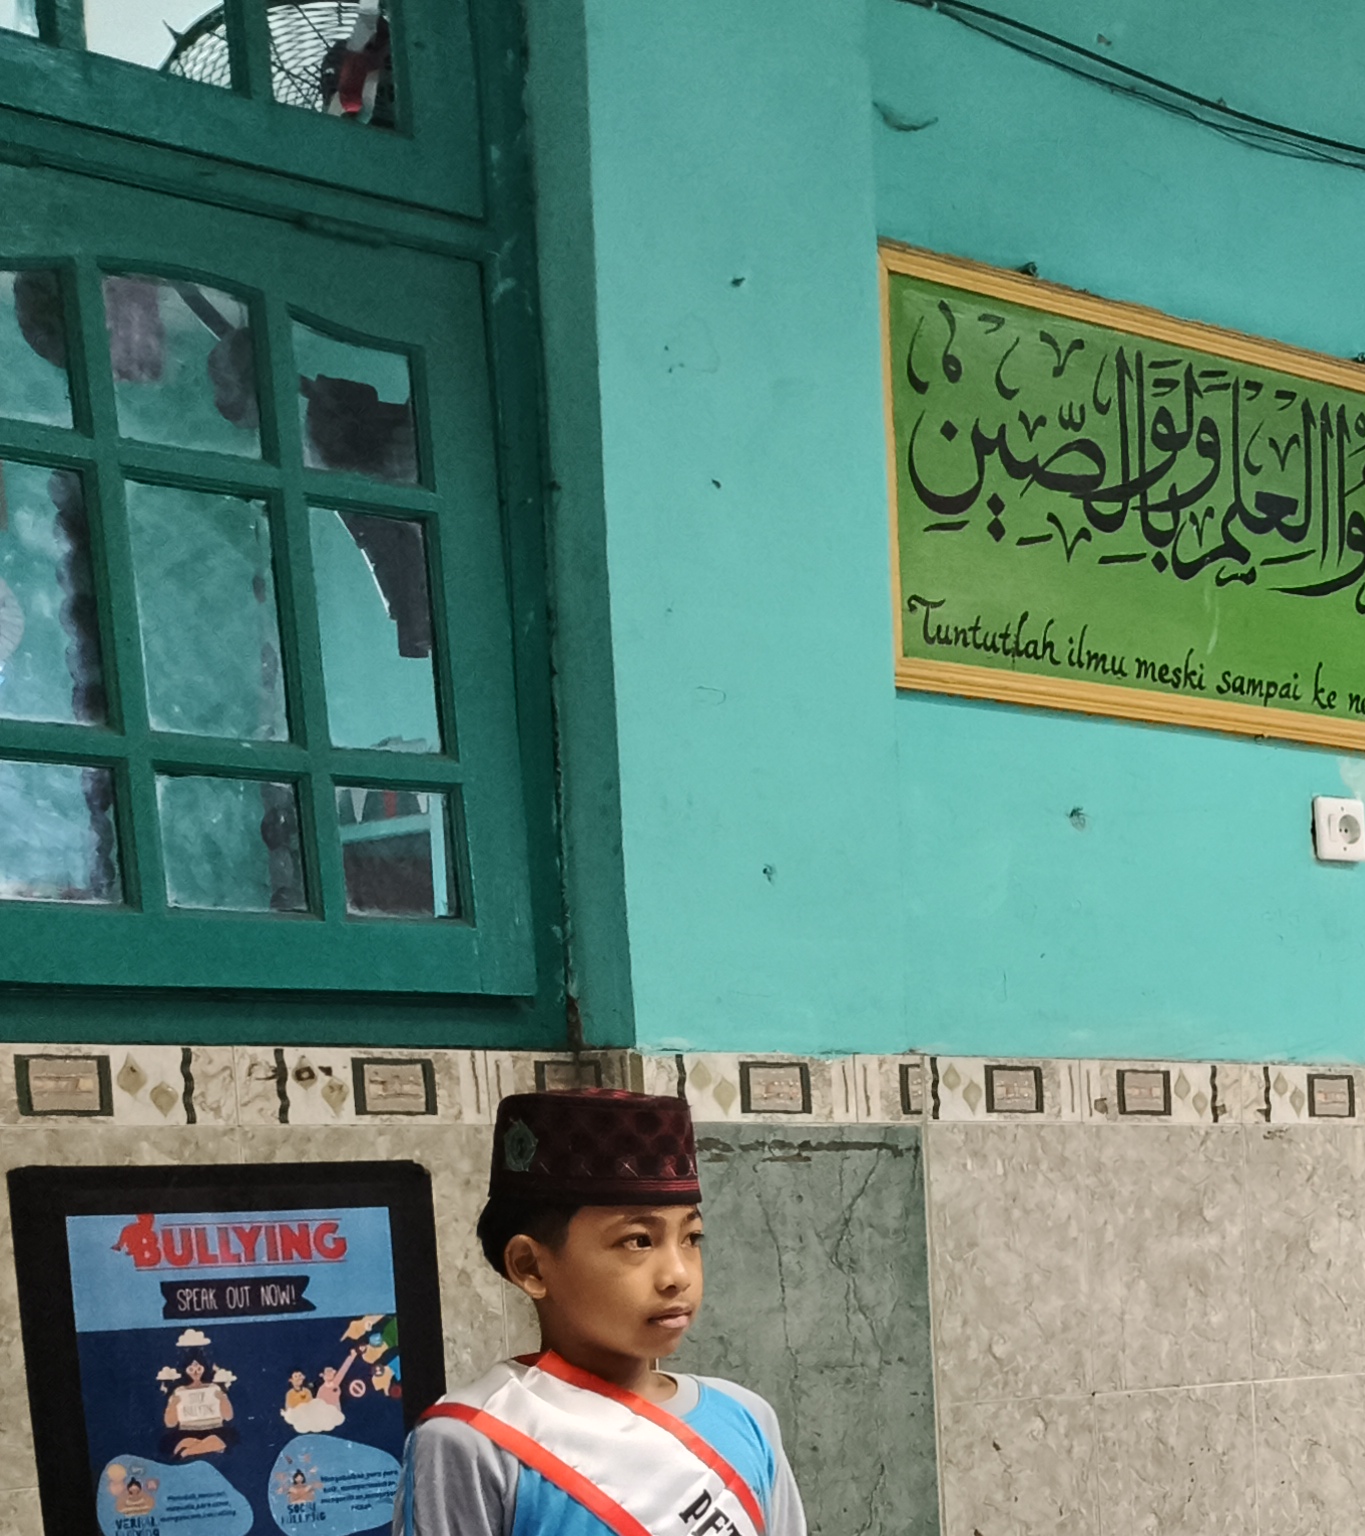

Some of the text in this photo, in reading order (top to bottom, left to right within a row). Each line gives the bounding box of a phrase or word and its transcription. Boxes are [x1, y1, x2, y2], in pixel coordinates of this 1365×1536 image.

[907, 595, 1063, 666] Tuntutlah
[1067, 625, 1128, 680] ilmu
[1133, 649, 1207, 692] meski
[1216, 667, 1301, 708] sampai
[1312, 663, 1337, 711] ke
[131, 1221, 348, 1267] BULLYING
[176, 1284, 296, 1312] SPEAK OUT NOW!
